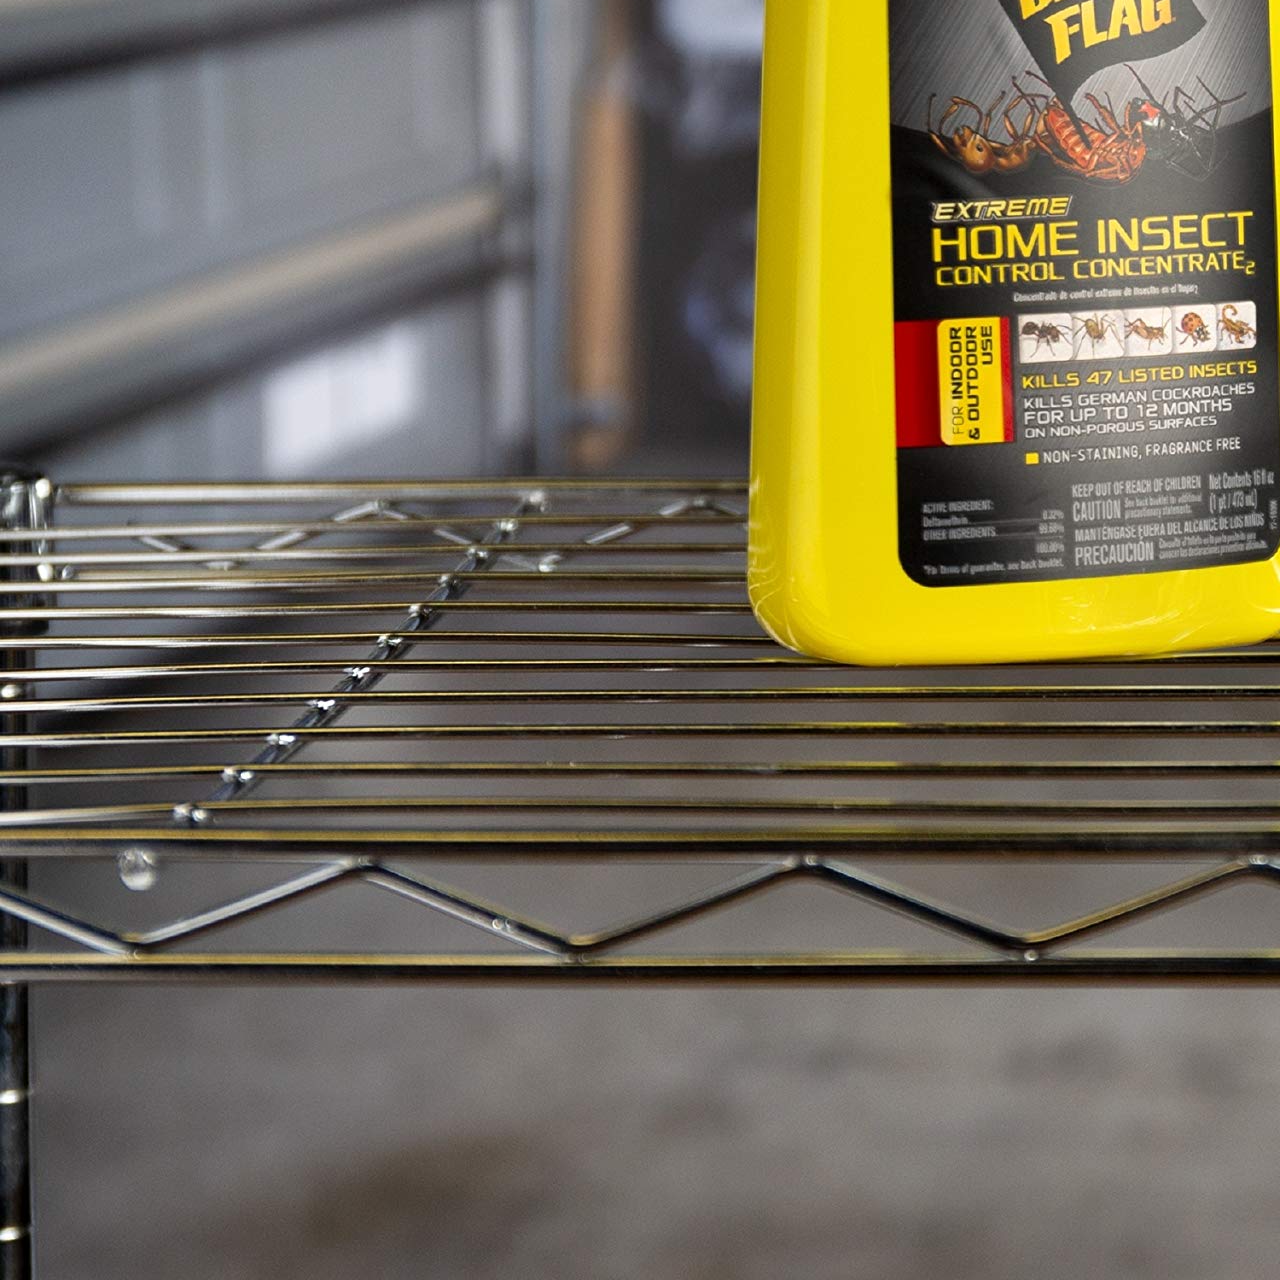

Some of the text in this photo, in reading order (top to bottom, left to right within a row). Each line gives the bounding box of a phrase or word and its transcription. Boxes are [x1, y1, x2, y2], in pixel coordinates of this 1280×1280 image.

[932, 196, 1071, 222] EXTREME
[932, 211, 1253, 262] HOME INSECT
[936, 262, 1065, 286] CONTROL
[980, 325, 993, 365] USE
[949, 327, 964, 435] FOR INDOOR
[965, 326, 980, 440] & OUTDOOR
[1021, 360, 1257, 389] KILLS 47 LISTED INSECTS
[1023, 382, 1256, 409] KILLS GERMAN COCKROACHES
[1023, 398, 1233, 425] FOR UP TO 12 MONTHS
[1024, 415, 1218, 439] ON NON-POROUS SURFACES
[1043, 436, 1241, 464] NON-STAINING, FRAGRANCE FREE
[1072, 475, 1201, 498] KEEP OUT OF REACH OF CHILDREN
[1072, 499, 1121, 522] CAUTION
[1138, 522, 1165, 537] FUERA
[1167, 522, 1183, 535] DEL
[1183, 518, 1218, 534] ALCANCE
[1219, 517, 1229, 530] DE
[1230, 515, 1244, 529] LOS
[1074, 540, 1154, 566] PRECAUCIÓN
